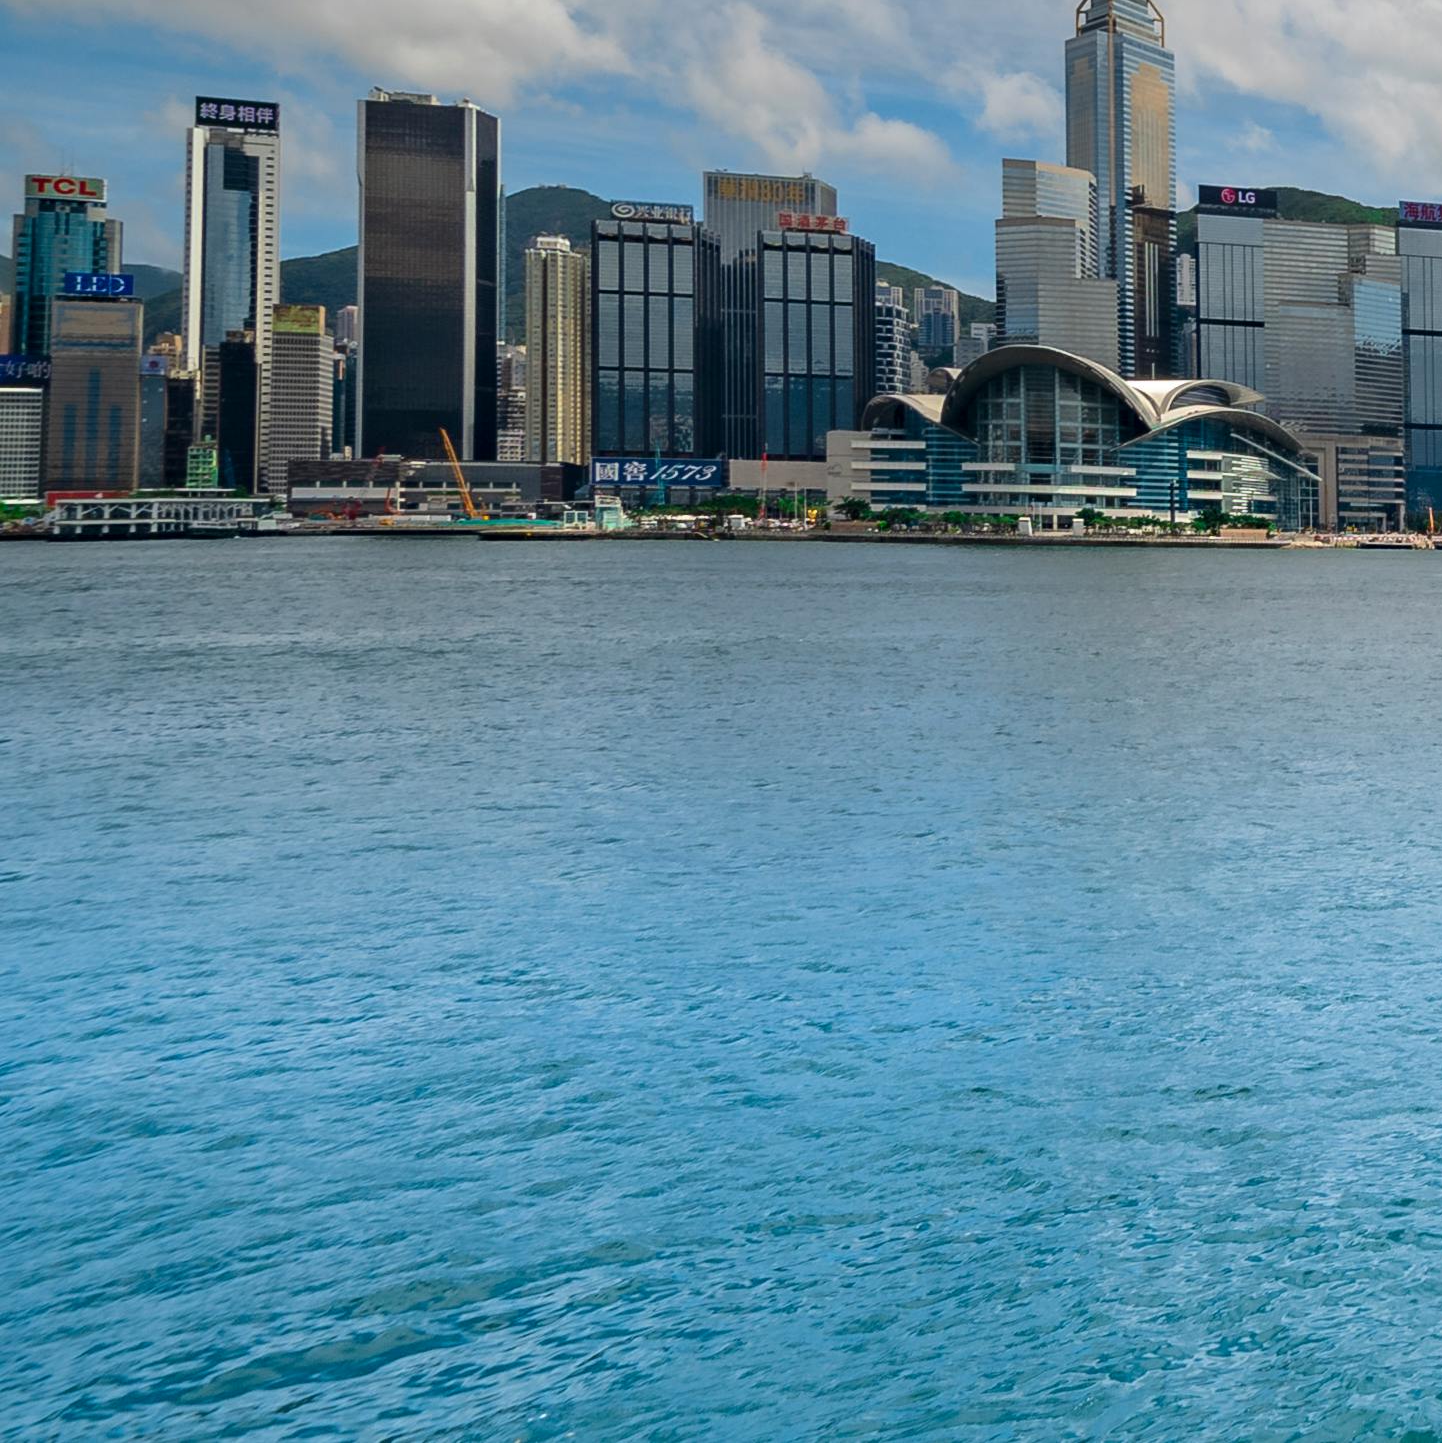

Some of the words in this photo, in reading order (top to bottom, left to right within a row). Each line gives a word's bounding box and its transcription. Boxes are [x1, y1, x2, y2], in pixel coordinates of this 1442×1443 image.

[200, 102, 274, 124] 終身相伴
[31, 176, 97, 197] TCL
[1238, 191, 1256, 204] LG
[75, 275, 126, 293] LED
